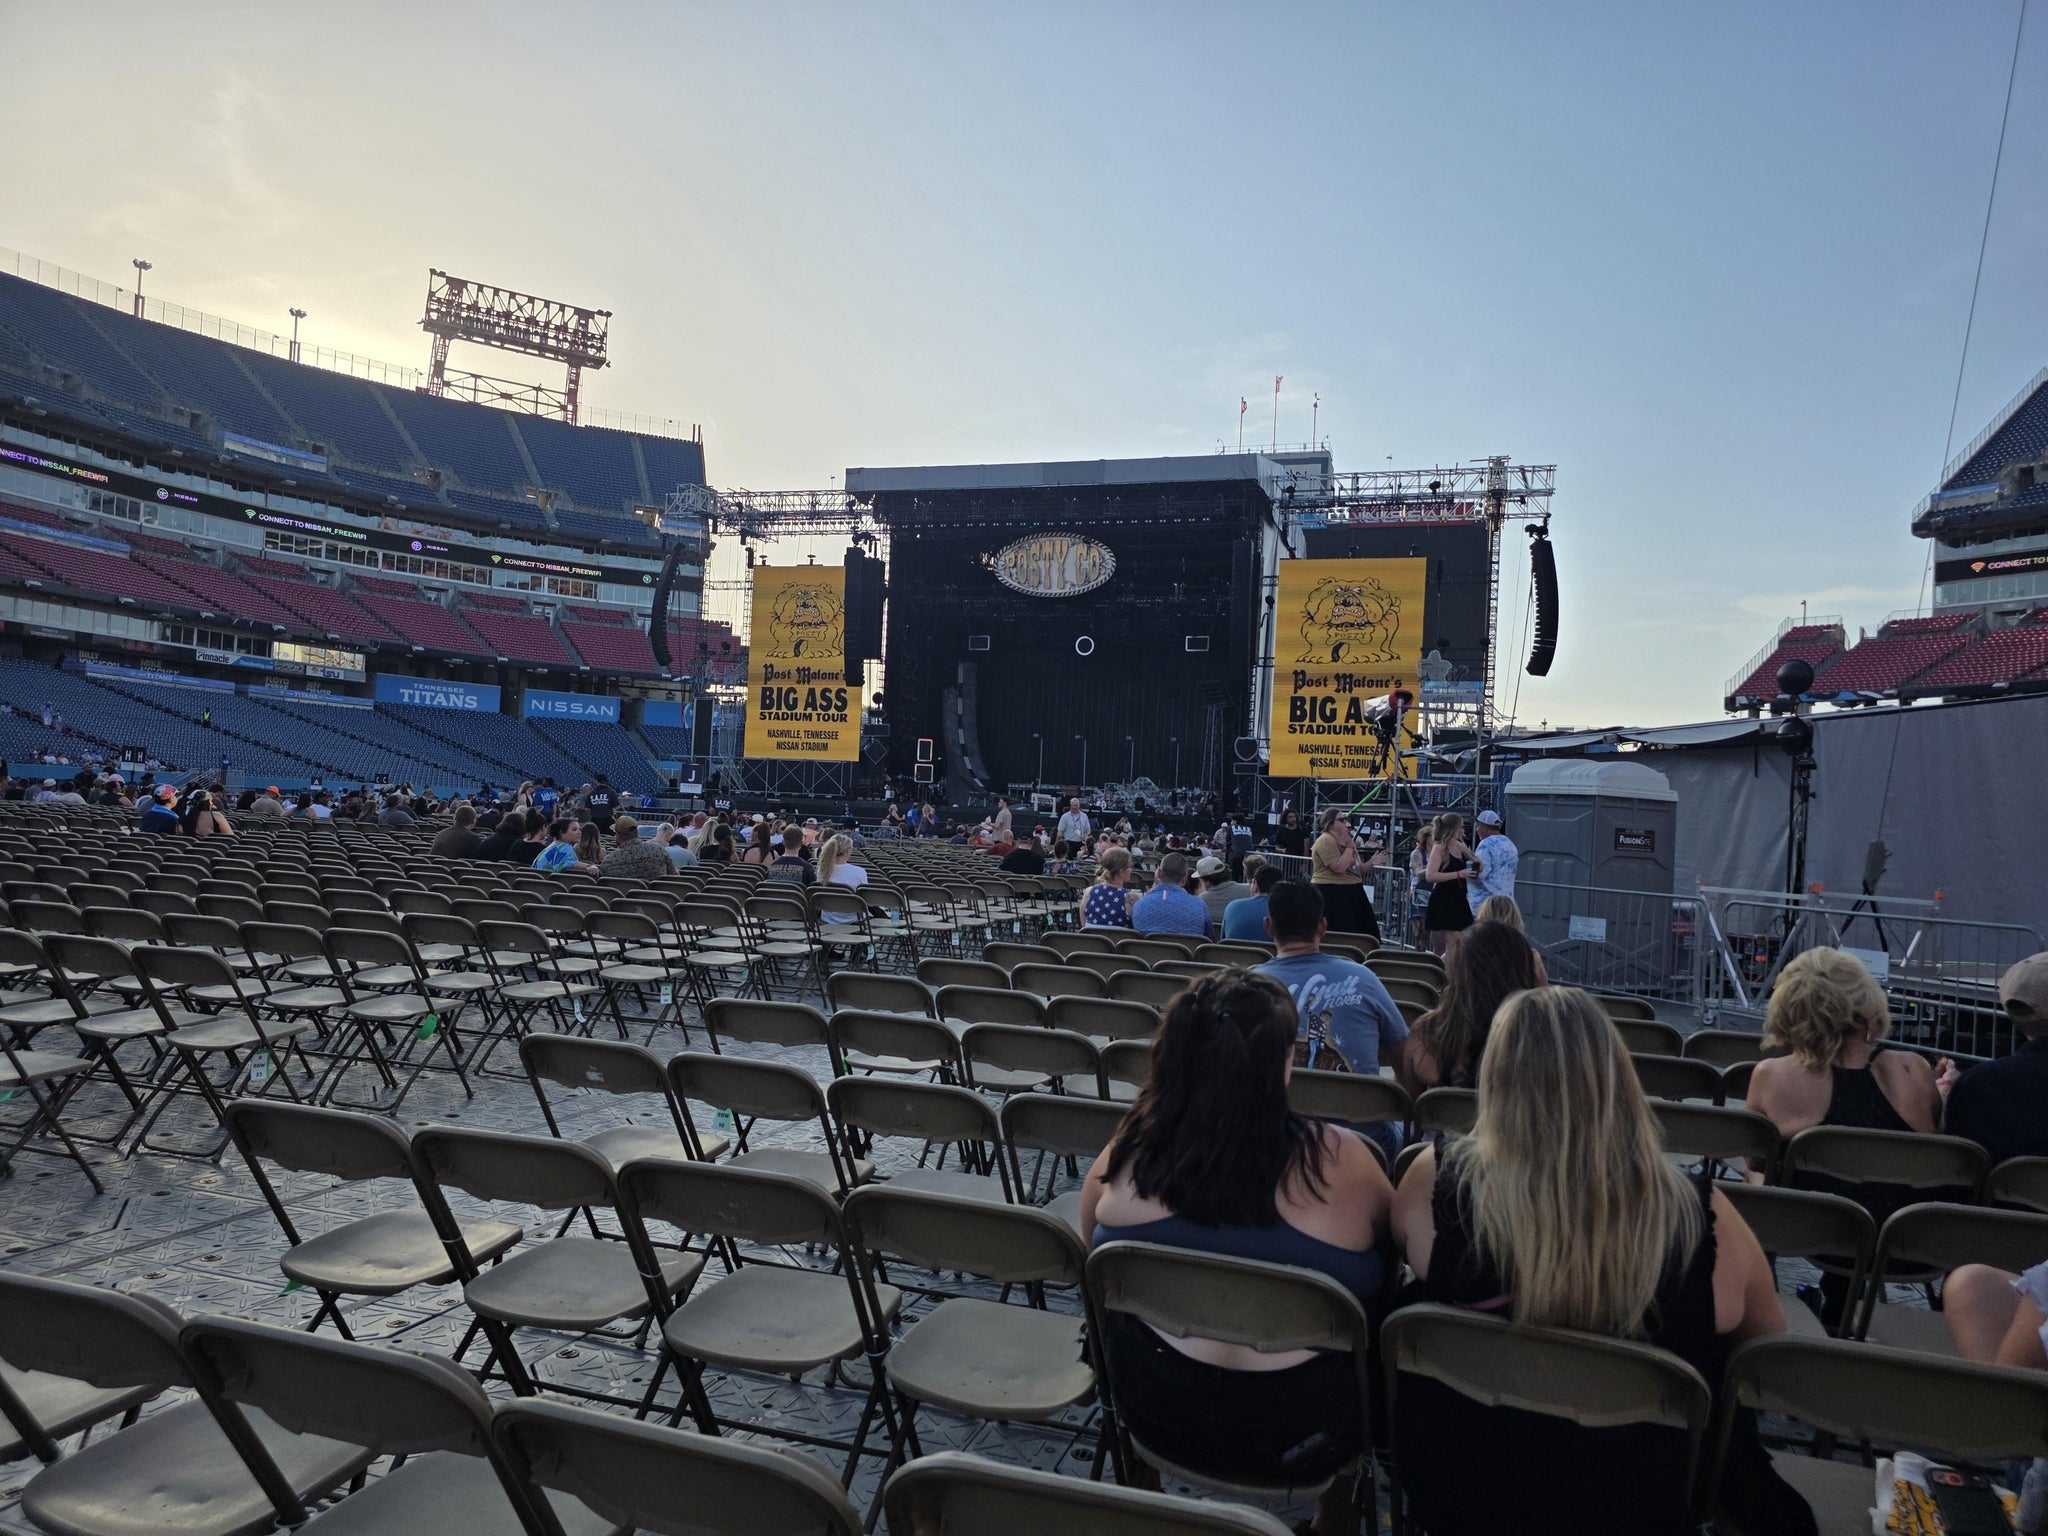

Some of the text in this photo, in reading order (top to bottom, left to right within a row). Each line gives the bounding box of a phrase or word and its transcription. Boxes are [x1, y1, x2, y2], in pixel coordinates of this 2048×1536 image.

[28, 455, 39, 465] TO
[40, 459, 108, 483] NISSAN_FREEWIFI
[259, 513, 367, 540] CONNECT TO NISSAN_FREEWIFI
[503, 558, 535, 567] CONNECT
[536, 561, 545, 569] TO
[1004, 539, 1101, 590] POSTY CO
[1988, 556, 2045, 569] CONNECT TO
[198, 651, 230, 663] Pinnacle
[763, 663, 792, 685] Post
[1293, 669, 1328, 694] Post
[413, 683, 465, 693] TENNESSEE
[400, 688, 478, 709] TITANS
[760, 686, 848, 712] BIG ASS
[531, 699, 614, 716] NISSAN
[1289, 695, 1337, 723] BIG
[759, 711, 848, 723] STADIUM TOUR
[767, 729, 839, 740] NASHVILLE, TENNESSEE
[1288, 723, 1356, 735] STADIUM
[776, 741, 829, 751] NISSAN STADIUM
[1298, 744, 1342, 756] NASHVILLE,
[125, 750, 131, 761] H
[138, 751, 143, 762] H
[1341, 759, 1372, 769] STADIU
[688, 770, 696, 782] J
[1374, 821, 1381, 829] D
[1323, 994, 1363, 1009] FLORES
